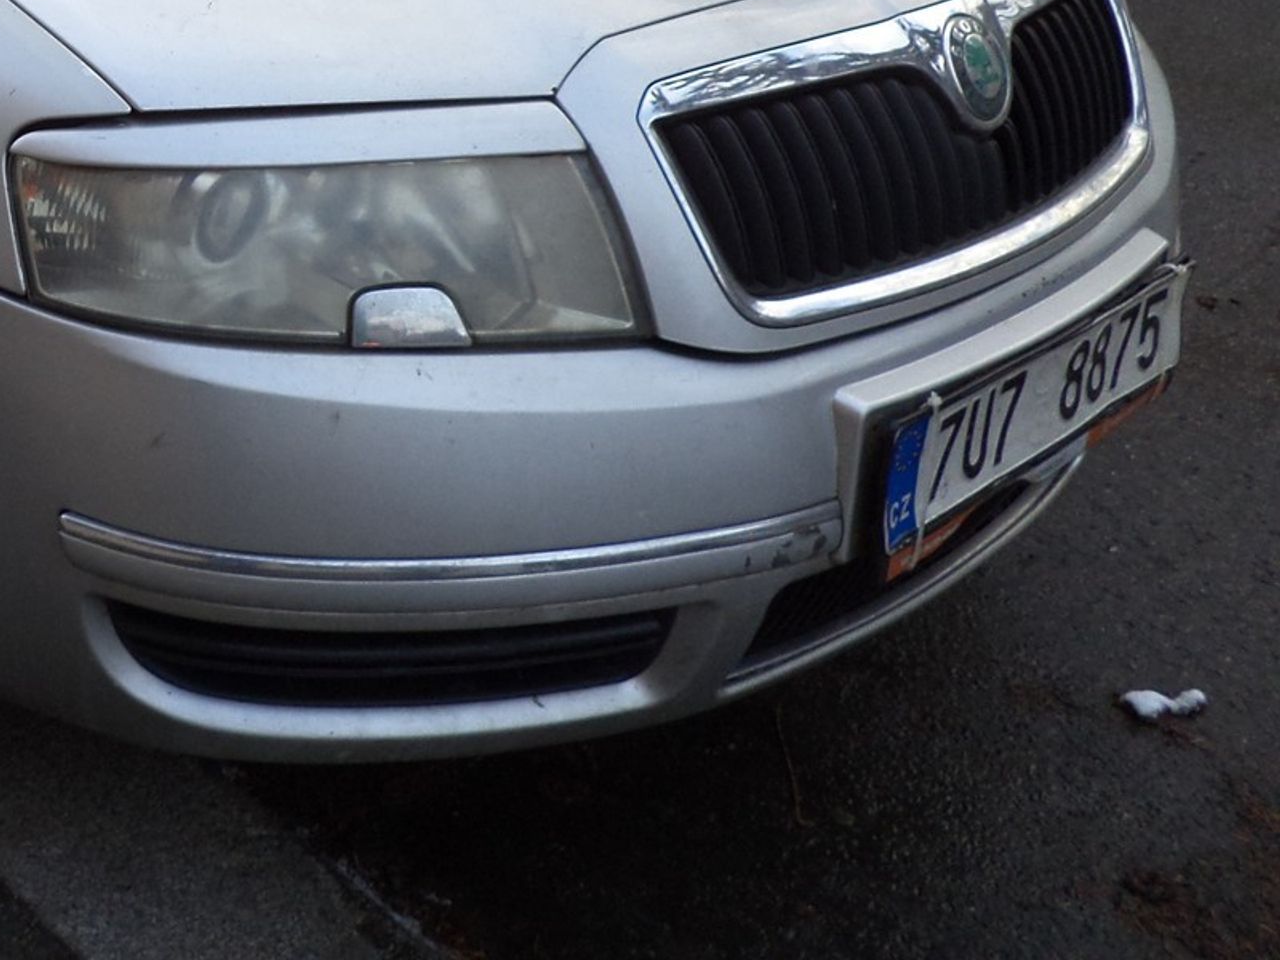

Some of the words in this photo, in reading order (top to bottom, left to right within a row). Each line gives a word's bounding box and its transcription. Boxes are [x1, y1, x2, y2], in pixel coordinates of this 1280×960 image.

[929, 371, 1028, 502] 7U7
[1059, 289, 1167, 420] 8875
[889, 494, 912, 529] CZ
